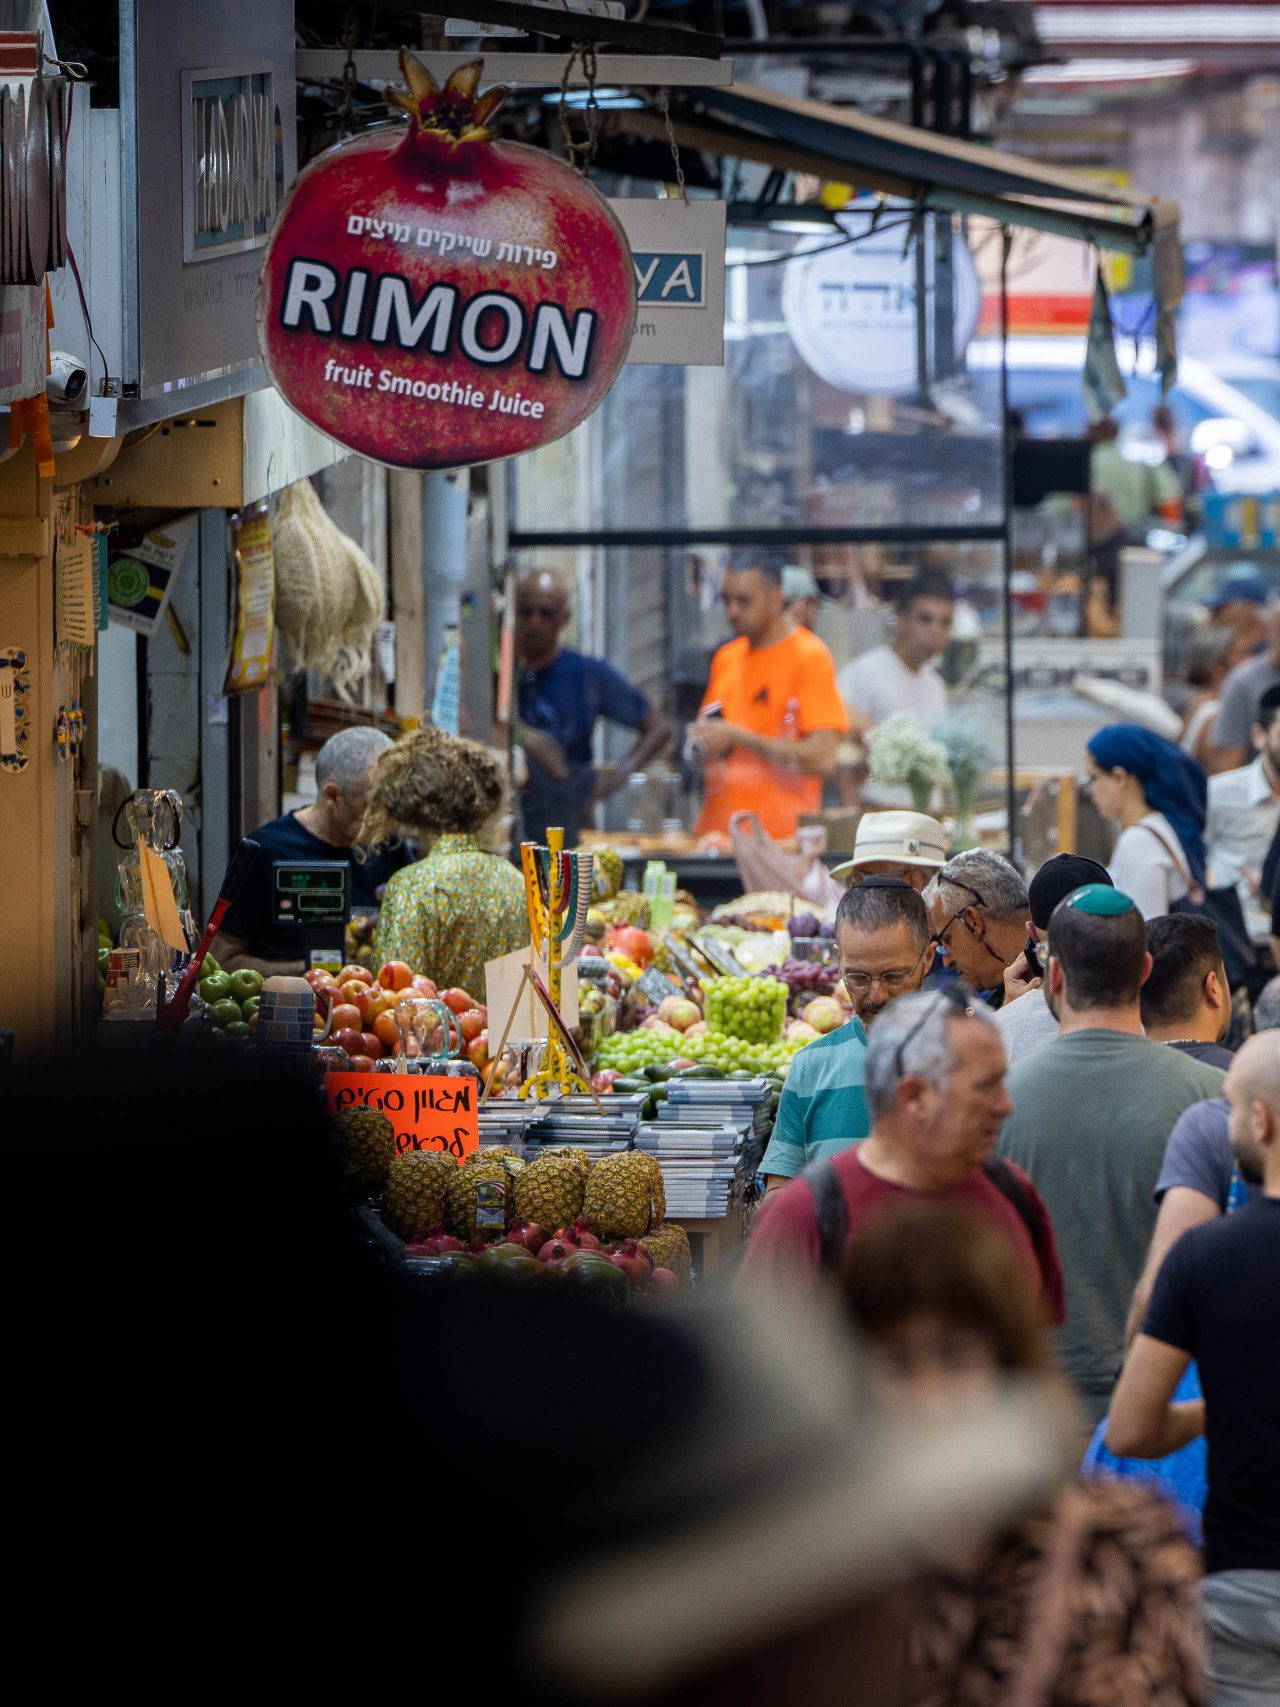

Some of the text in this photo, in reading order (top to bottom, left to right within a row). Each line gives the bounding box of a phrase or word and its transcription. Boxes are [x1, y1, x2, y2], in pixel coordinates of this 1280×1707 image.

[346, 214, 558, 269] פירות שייקים מיצים
[282, 260, 594, 378] RIMON
[324, 359, 546, 419] fruit Smoothie Juice
[334, 1085, 470, 1124] מגוון סטים
